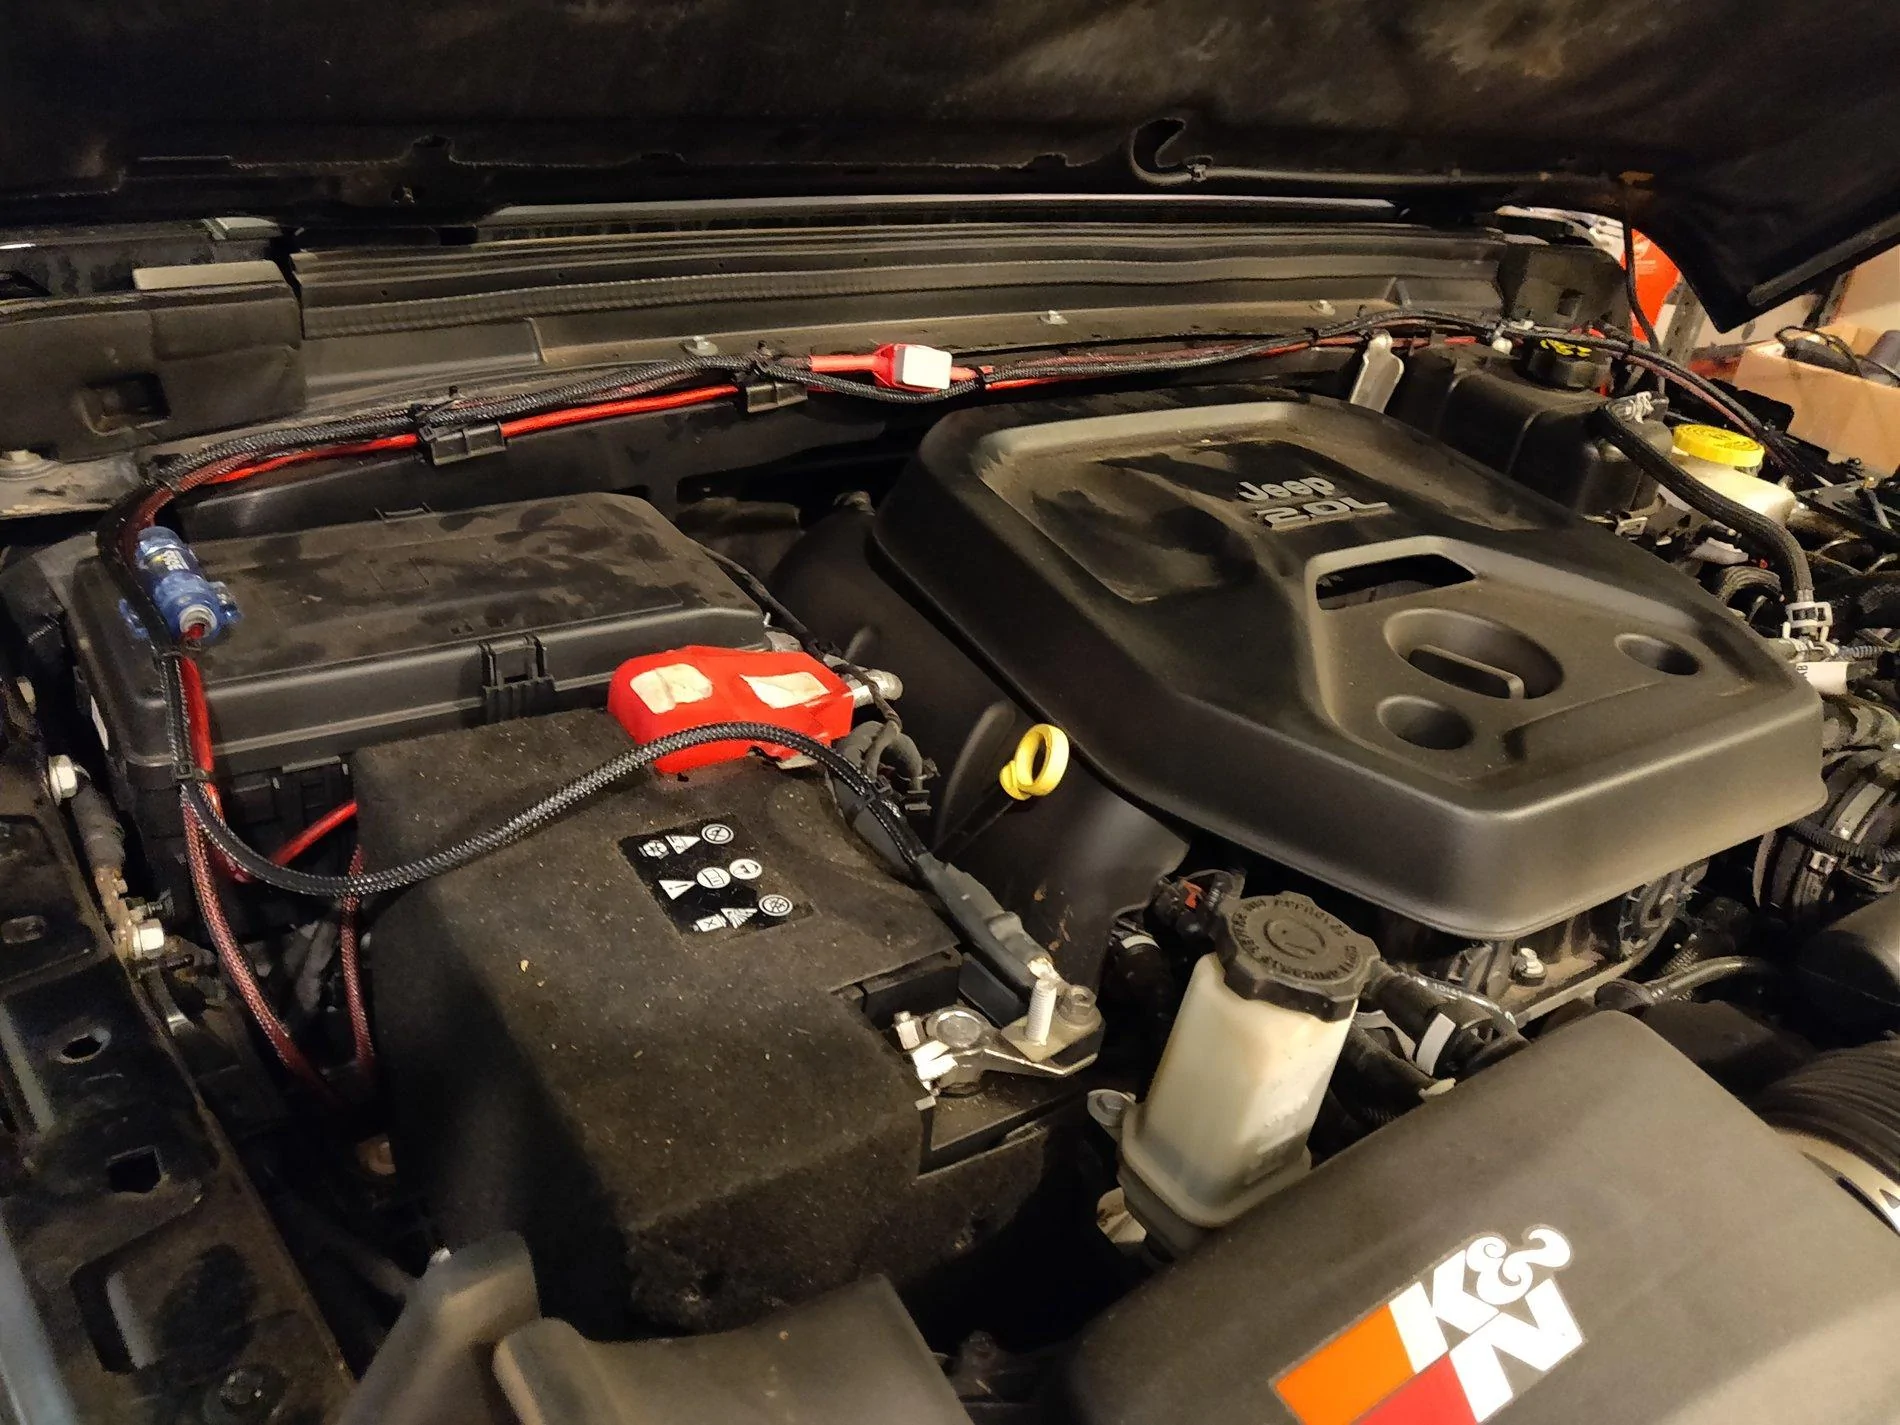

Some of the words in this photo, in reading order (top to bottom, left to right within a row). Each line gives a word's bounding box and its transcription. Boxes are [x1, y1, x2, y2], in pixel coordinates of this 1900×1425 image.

[1237, 477, 1336, 500] Jeep
[1256, 497, 1391, 527] 2.0L
[1388, 1227, 1584, 1424] K&N
